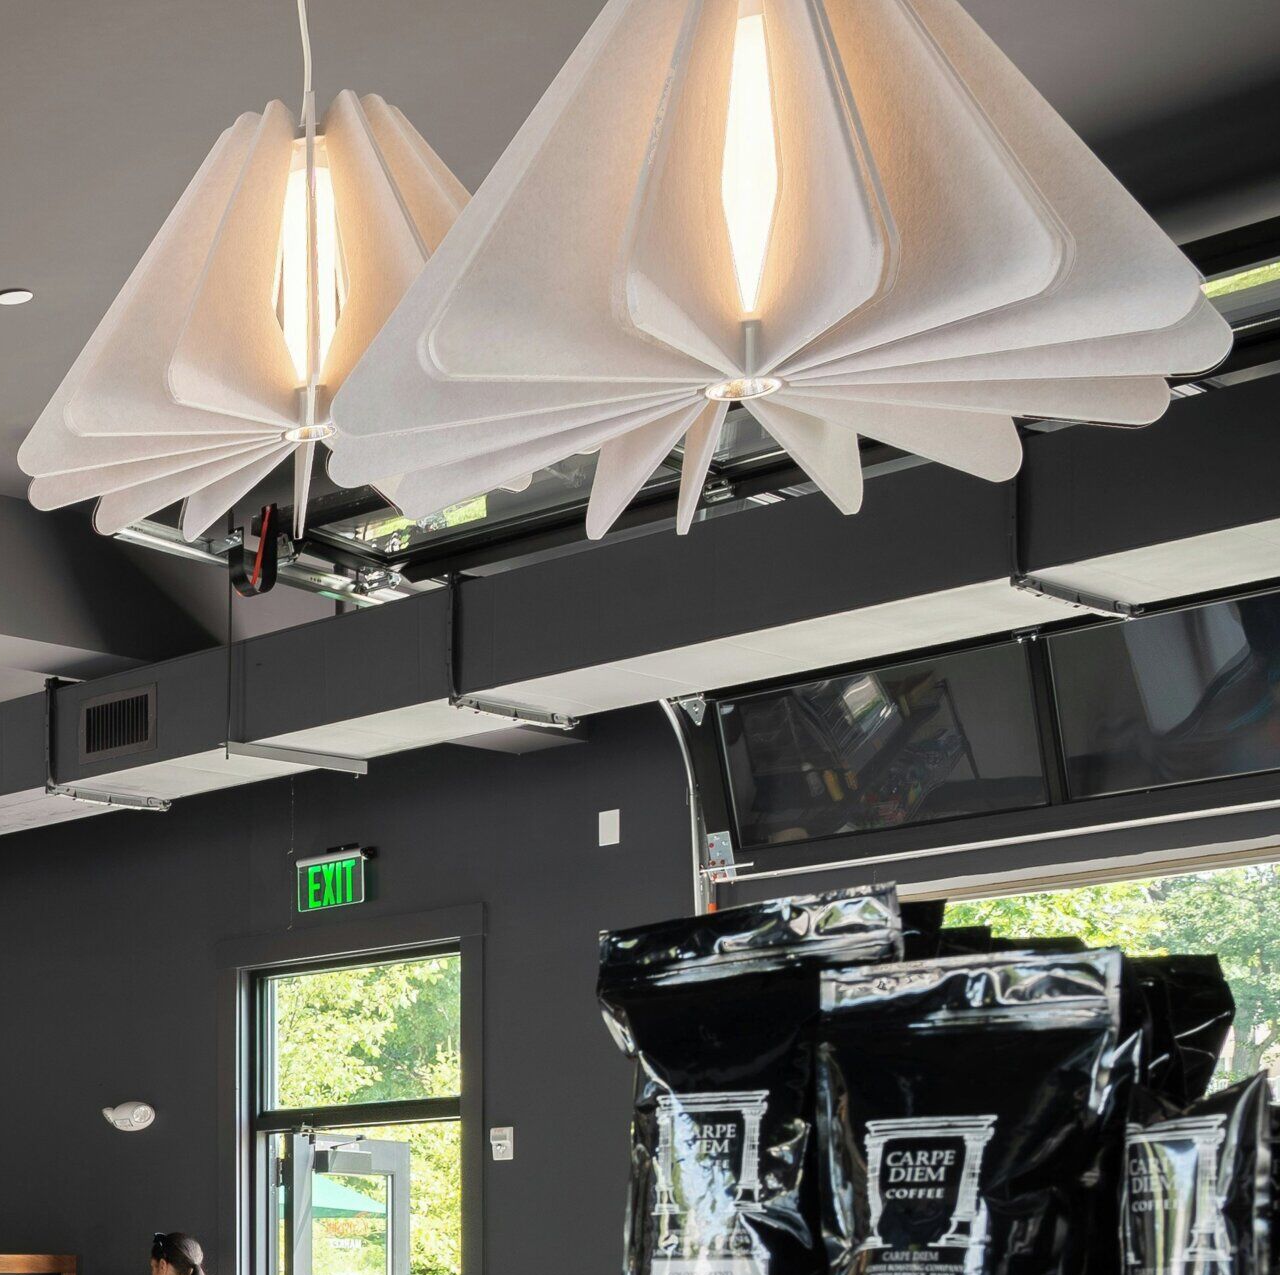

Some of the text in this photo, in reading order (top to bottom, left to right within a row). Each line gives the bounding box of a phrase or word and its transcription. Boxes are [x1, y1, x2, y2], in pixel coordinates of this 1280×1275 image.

[308, 860, 355, 908] EXIT
[690, 1123, 737, 1139] ARPE
[886, 1150, 956, 1166] CARPE
[888, 1166, 946, 1183] DIEM
[885, 1188, 945, 1200] COFFEE
[882, 1251, 939, 1262] CARPE DIEM
